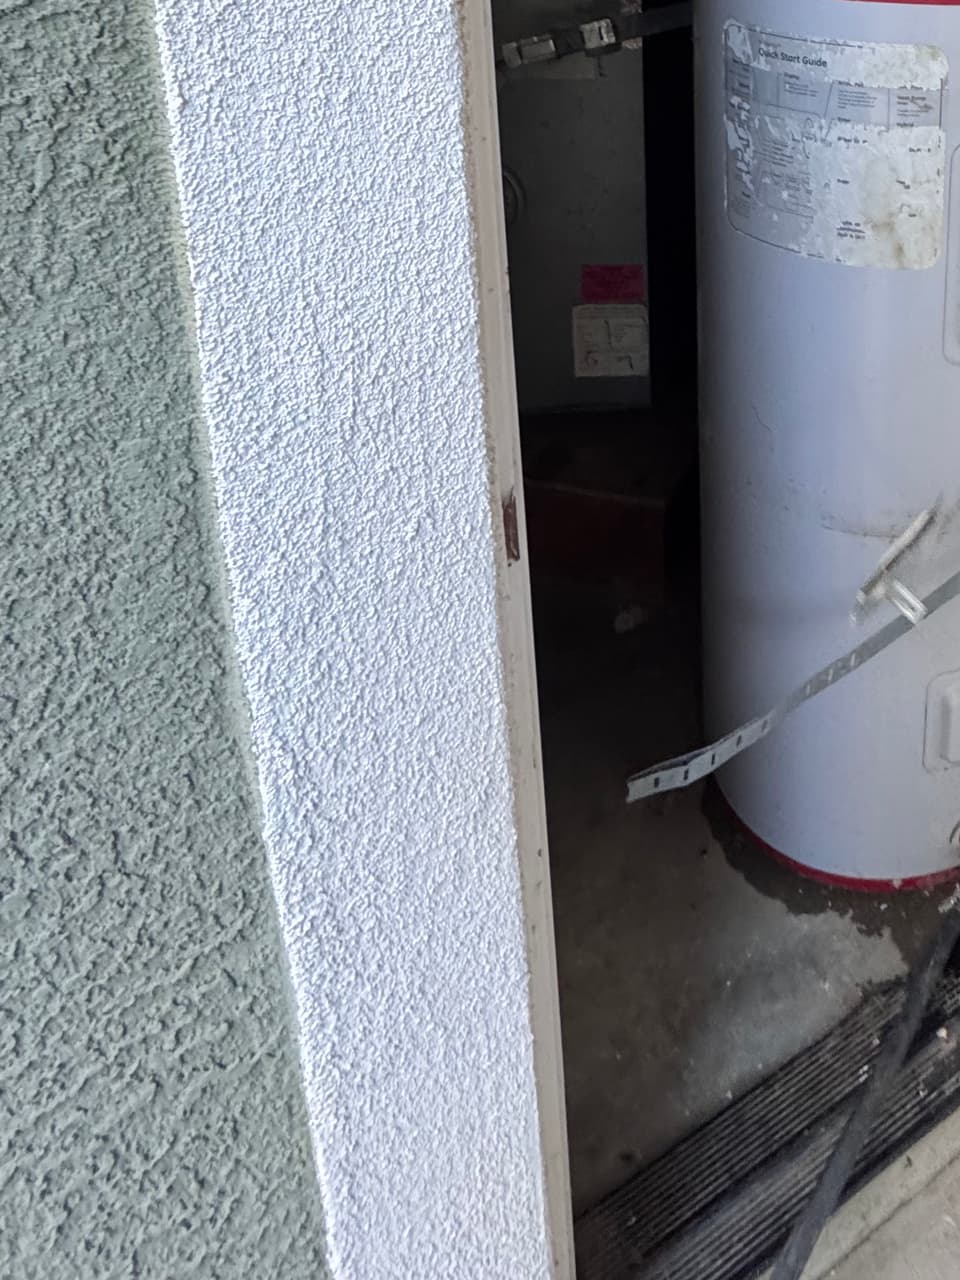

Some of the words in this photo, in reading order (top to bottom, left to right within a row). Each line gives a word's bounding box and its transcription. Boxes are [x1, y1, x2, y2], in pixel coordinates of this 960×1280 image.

[758, 47, 778, 59] Quick
[780, 51, 801, 64] Start
[802, 55, 828, 68] Guide
